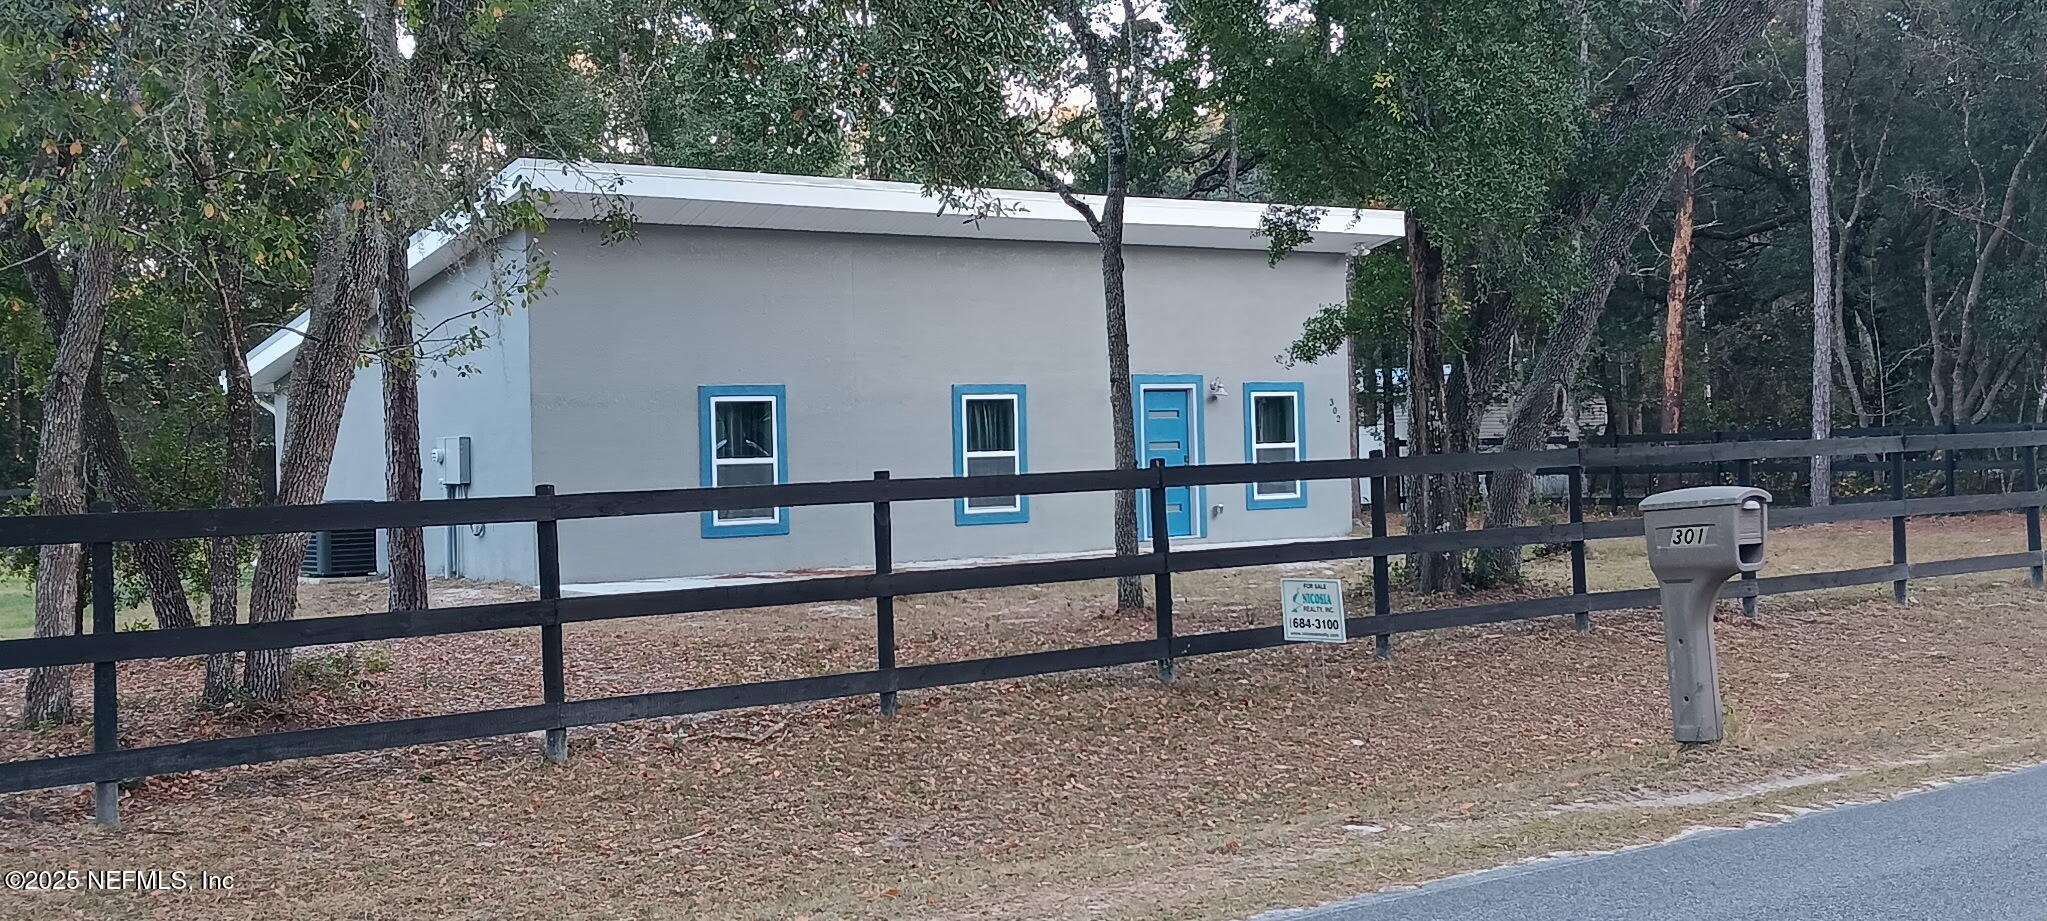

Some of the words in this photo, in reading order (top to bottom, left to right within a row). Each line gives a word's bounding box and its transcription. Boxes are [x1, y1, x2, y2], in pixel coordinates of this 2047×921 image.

[1329, 397, 1341, 423] 302
[1672, 528, 1704, 545] 301
[1302, 593, 1332, 605] NICOSIA
[1293, 618, 1339, 630] 684-3100
